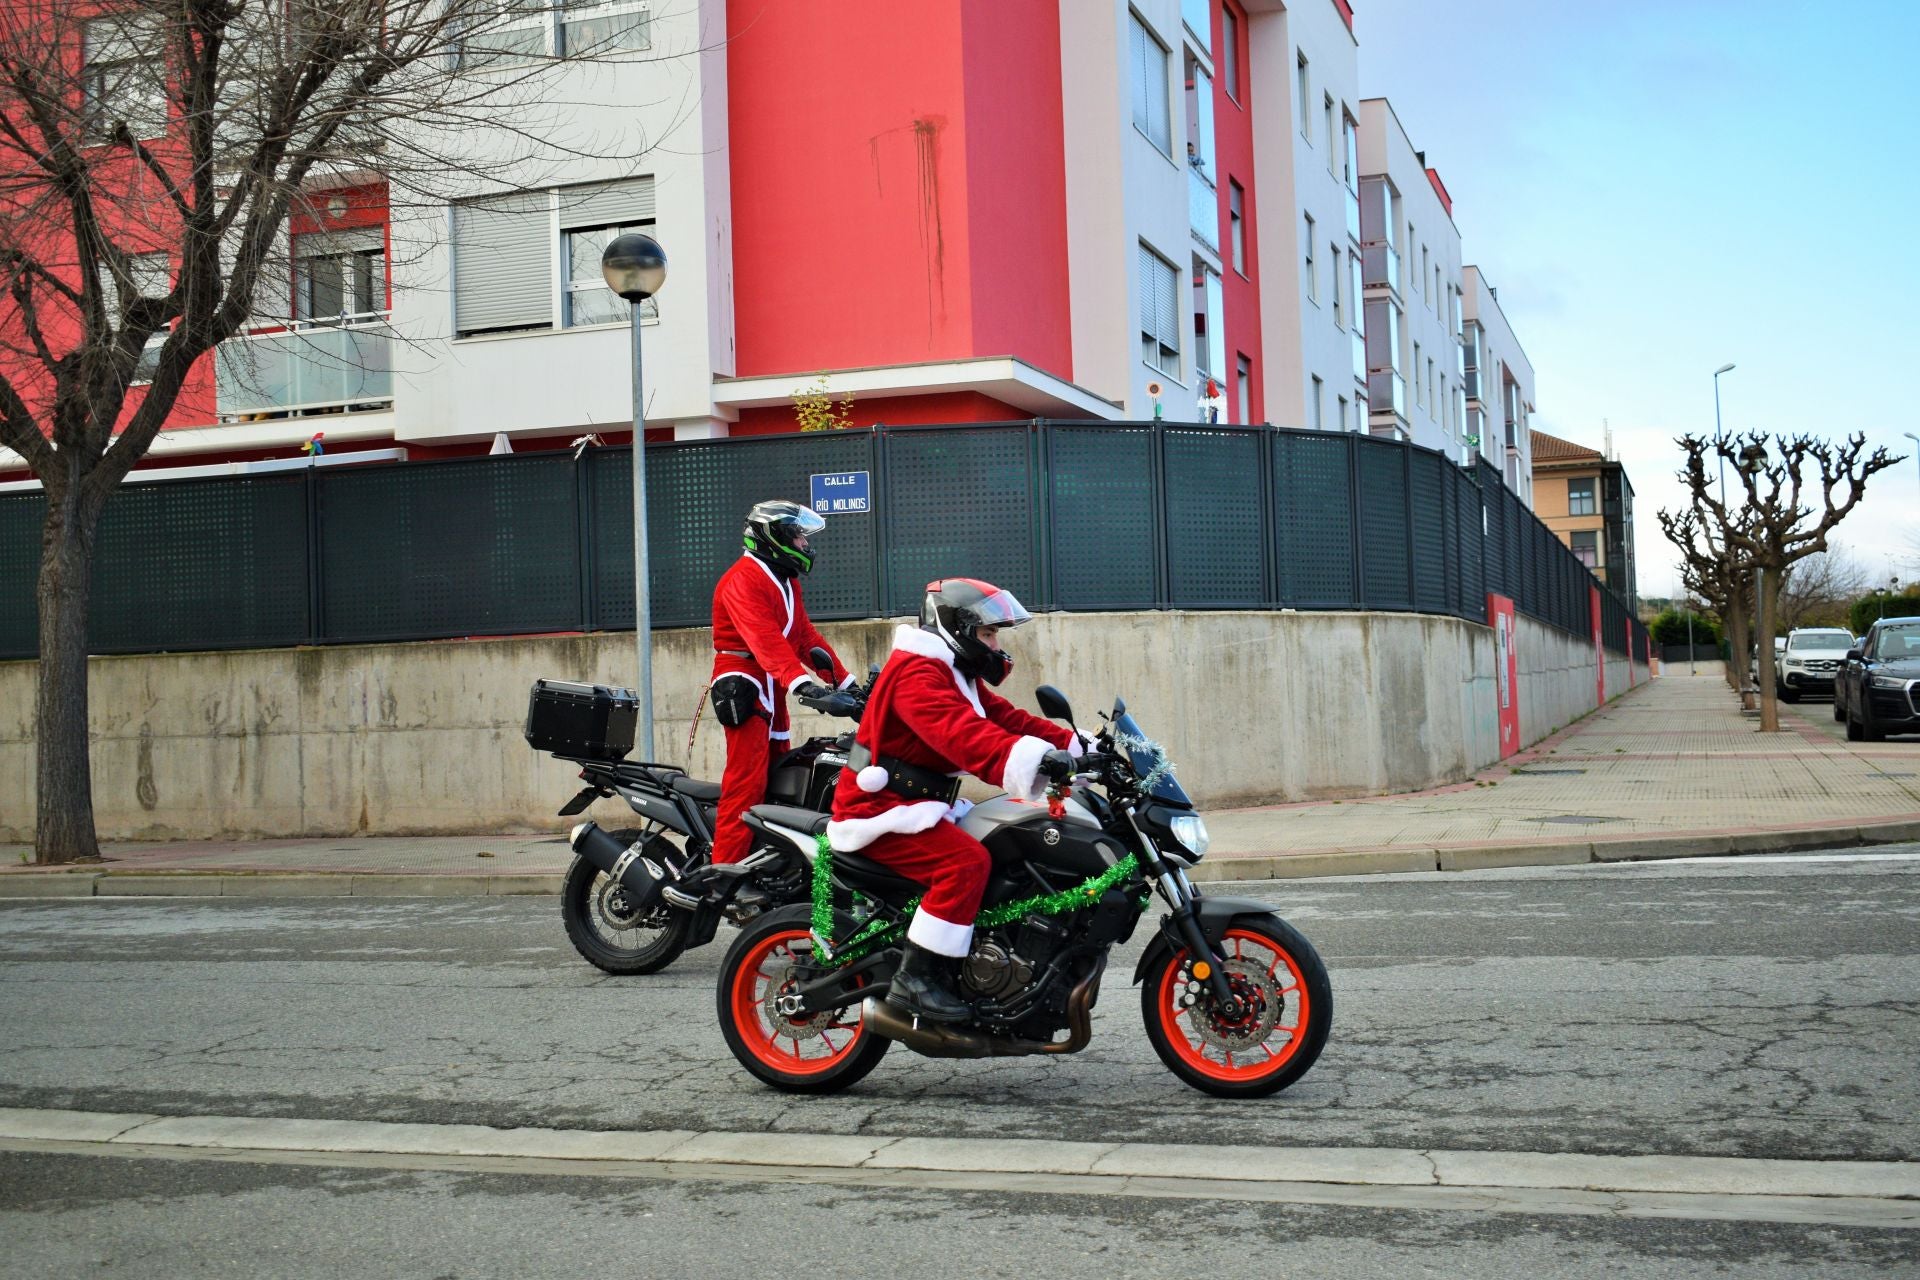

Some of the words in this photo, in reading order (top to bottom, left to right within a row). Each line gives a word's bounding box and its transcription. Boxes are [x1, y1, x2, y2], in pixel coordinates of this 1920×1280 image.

[825, 476, 855, 485] CALLE
[816, 498, 828, 511] RÍO
[833, 498, 865, 510] MOLINOS
